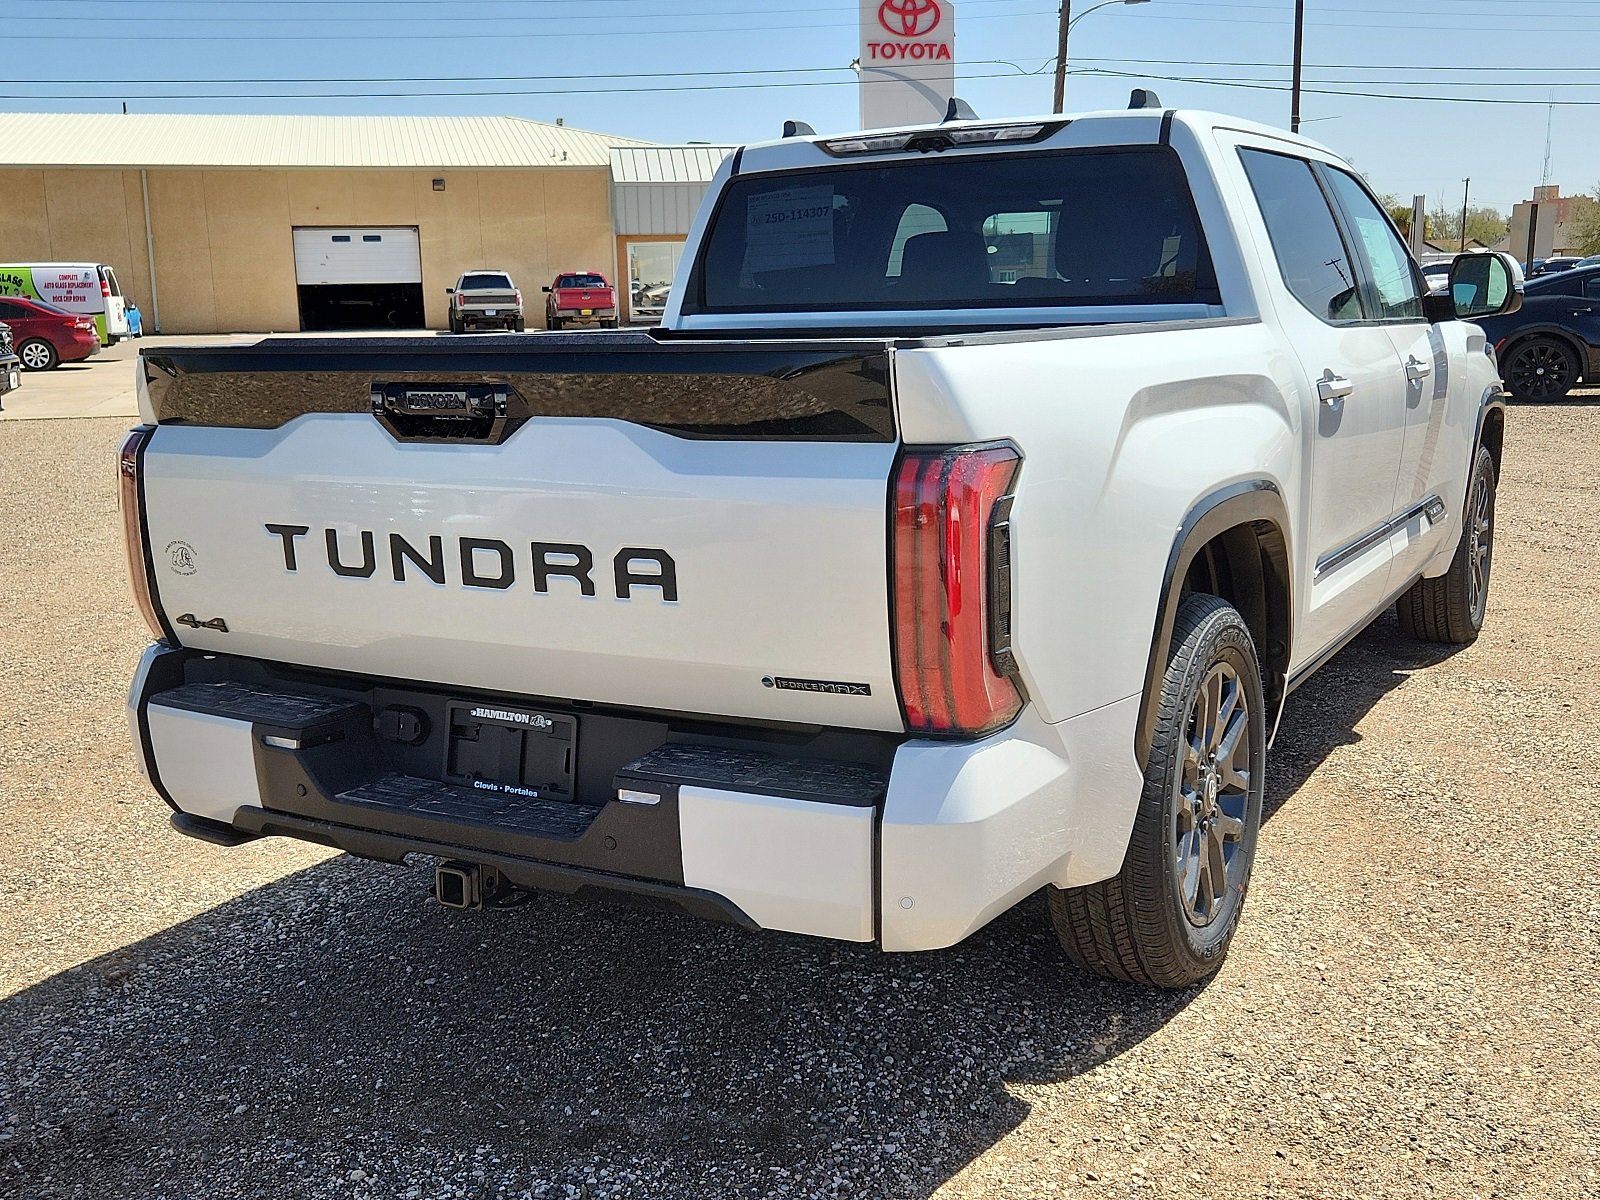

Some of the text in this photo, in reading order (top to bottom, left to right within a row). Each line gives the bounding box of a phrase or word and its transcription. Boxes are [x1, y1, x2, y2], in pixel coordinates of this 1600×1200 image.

[867, 43, 951, 60] TOYOTA
[765, 206, 830, 224] 25D-114307
[0, 273, 23, 288] LASS
[410, 393, 464, 409] TOYOTA
[264, 523, 678, 602] TUNDRA
[475, 707, 530, 724] HAMILTON
[474, 781, 538, 798] Clovis Portales
